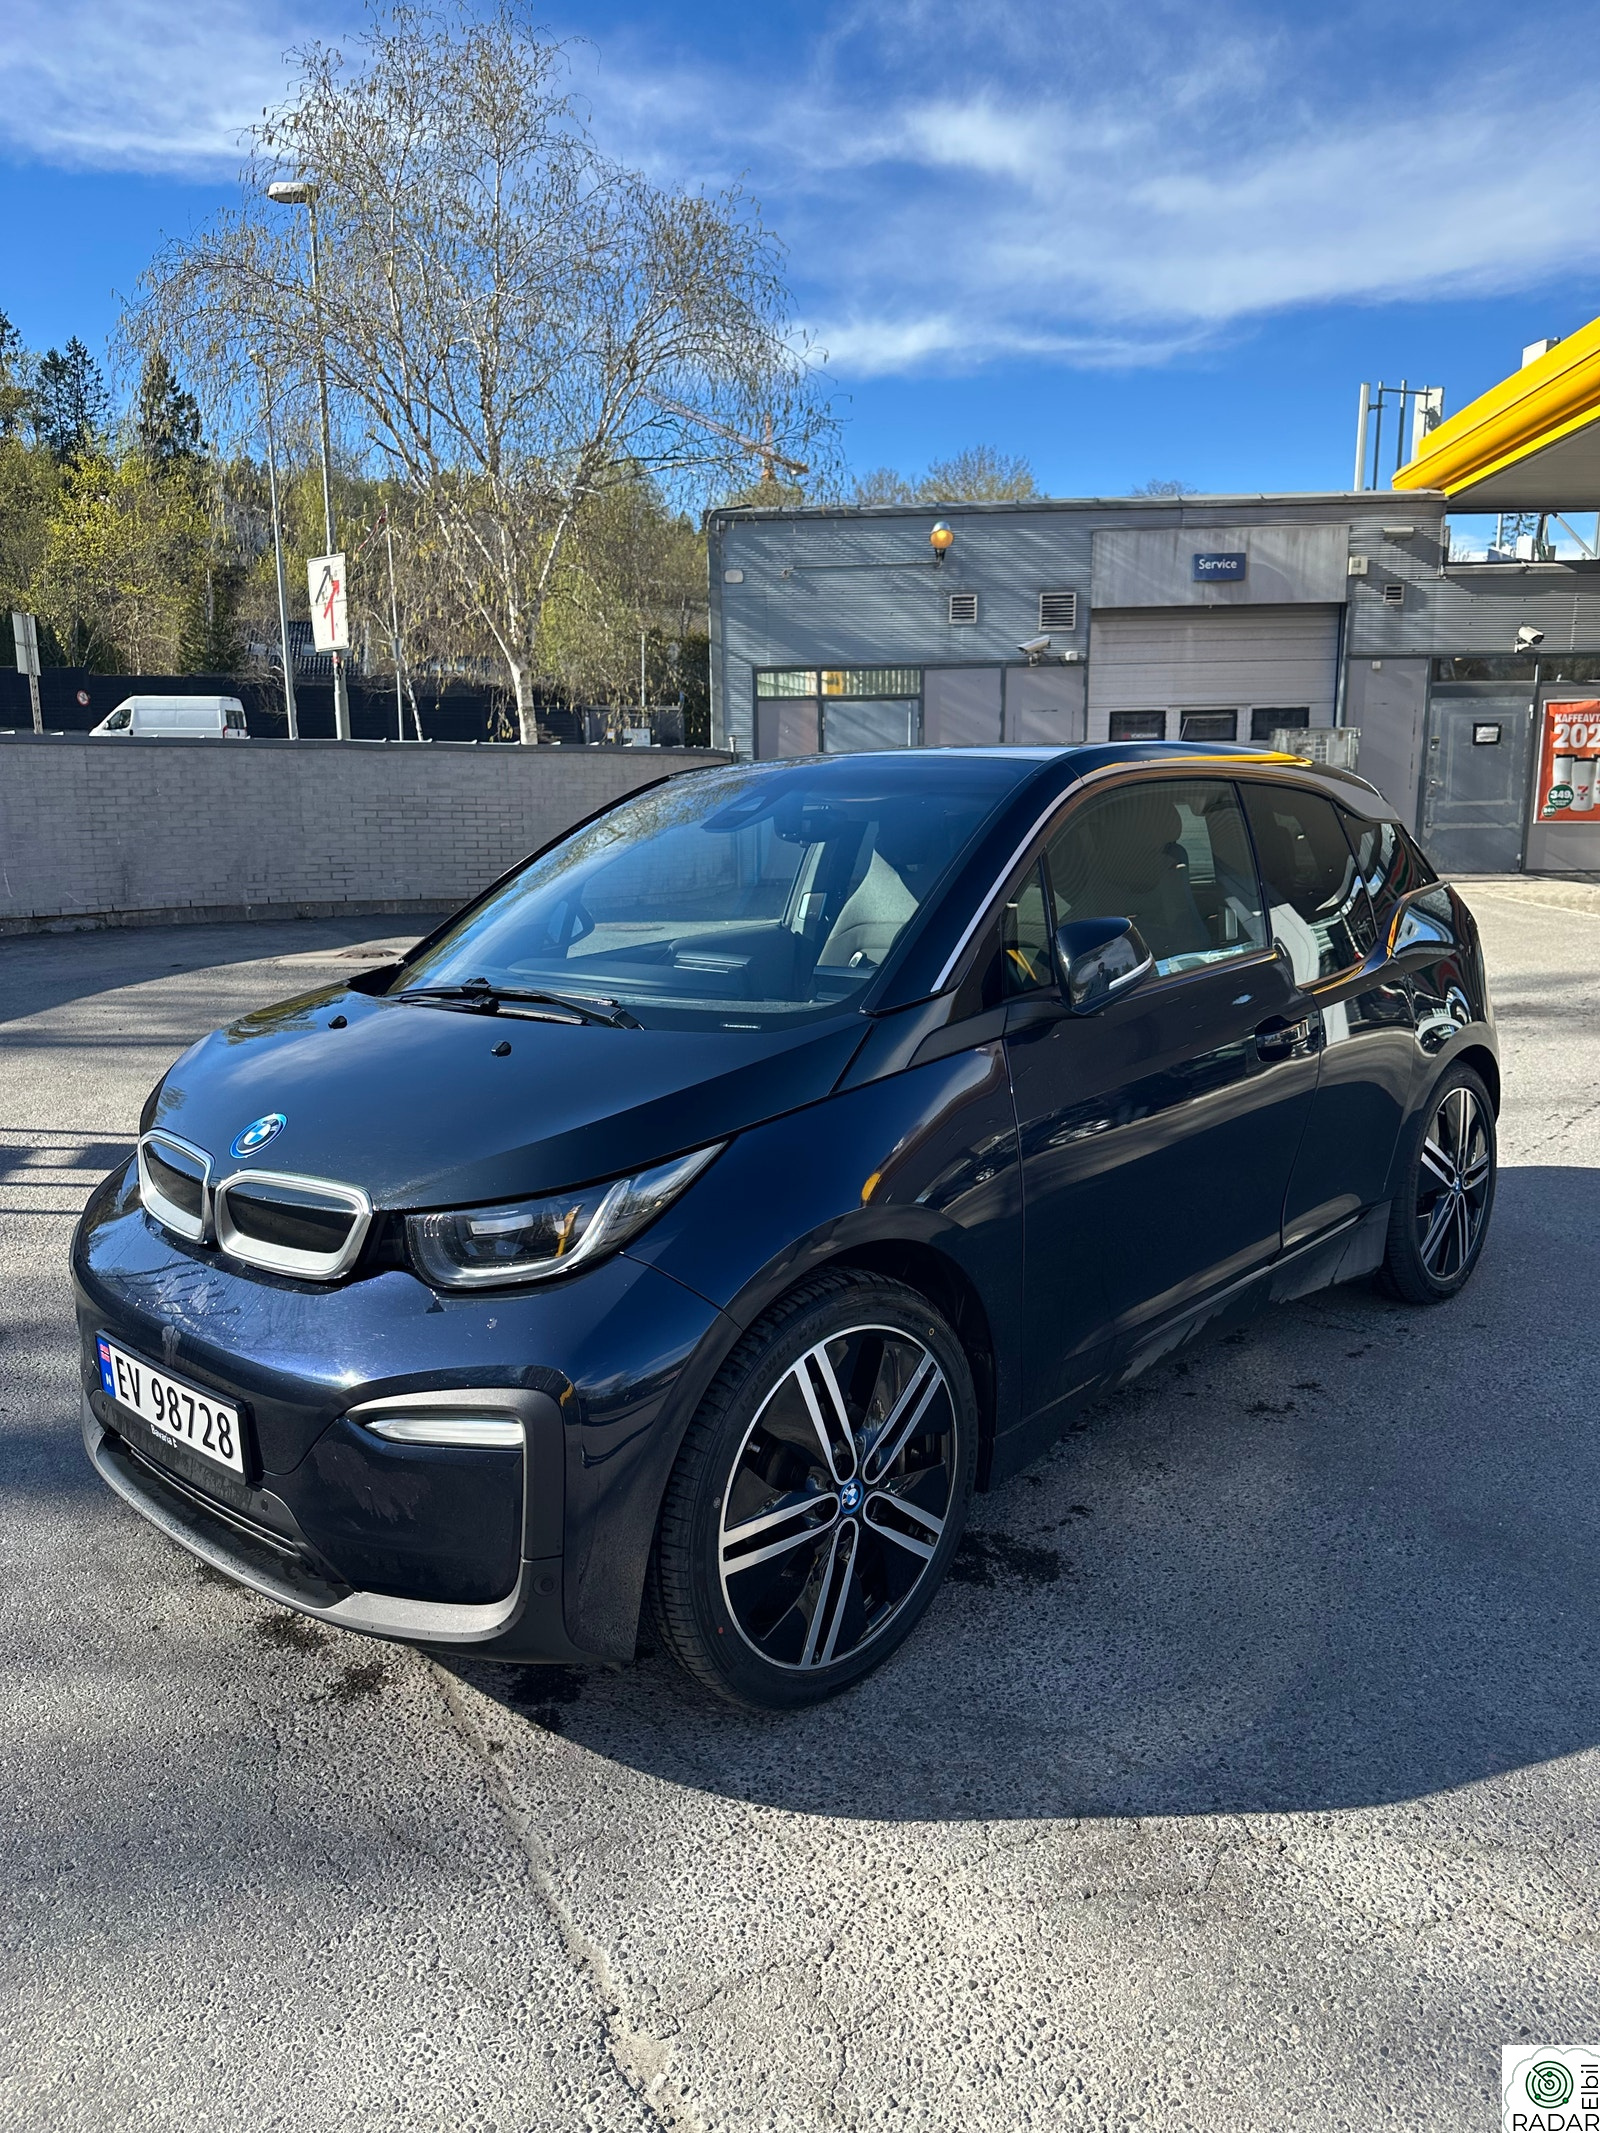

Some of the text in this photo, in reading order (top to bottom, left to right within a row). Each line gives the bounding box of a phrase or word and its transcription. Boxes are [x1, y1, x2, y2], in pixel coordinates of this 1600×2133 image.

[1198, 558, 1238, 570] Service
[1552, 723, 1600, 749] 202
[105, 1373, 112, 1387] N
[115, 1355, 233, 1460] EV 98728
